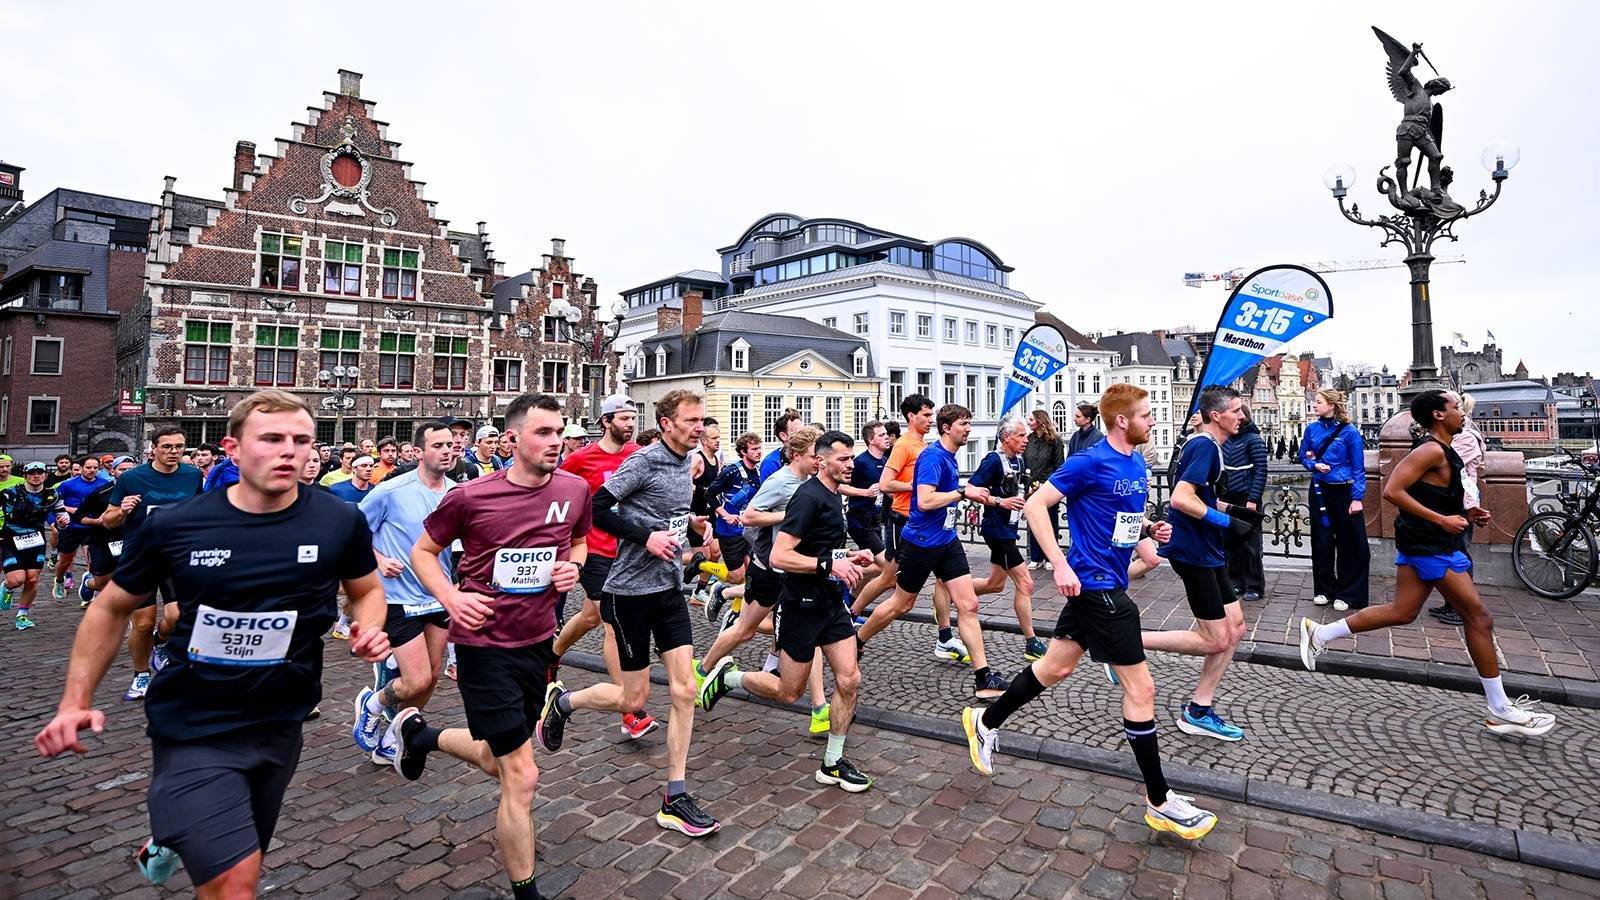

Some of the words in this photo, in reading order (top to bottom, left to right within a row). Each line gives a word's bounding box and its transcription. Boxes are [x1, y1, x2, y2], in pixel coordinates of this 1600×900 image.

[1251, 283, 1303, 303] Sportoase
[1235, 301, 1295, 335] 3:15
[1223, 333, 1265, 350] Marathon
[1019, 348, 1050, 376] 3:15
[1012, 370, 1034, 386] Marathon
[545, 501, 570, 524] N
[190, 548, 232, 560] running
[500, 551, 553, 563] SOFICO
[200, 557, 226, 567] ugly.
[517, 565, 538, 576] 937
[511, 576, 540, 585] Mathijs
[202, 613, 289, 630] SOFICO
[220, 632, 263, 646] 5318
[224, 645, 254, 658] Stijn
